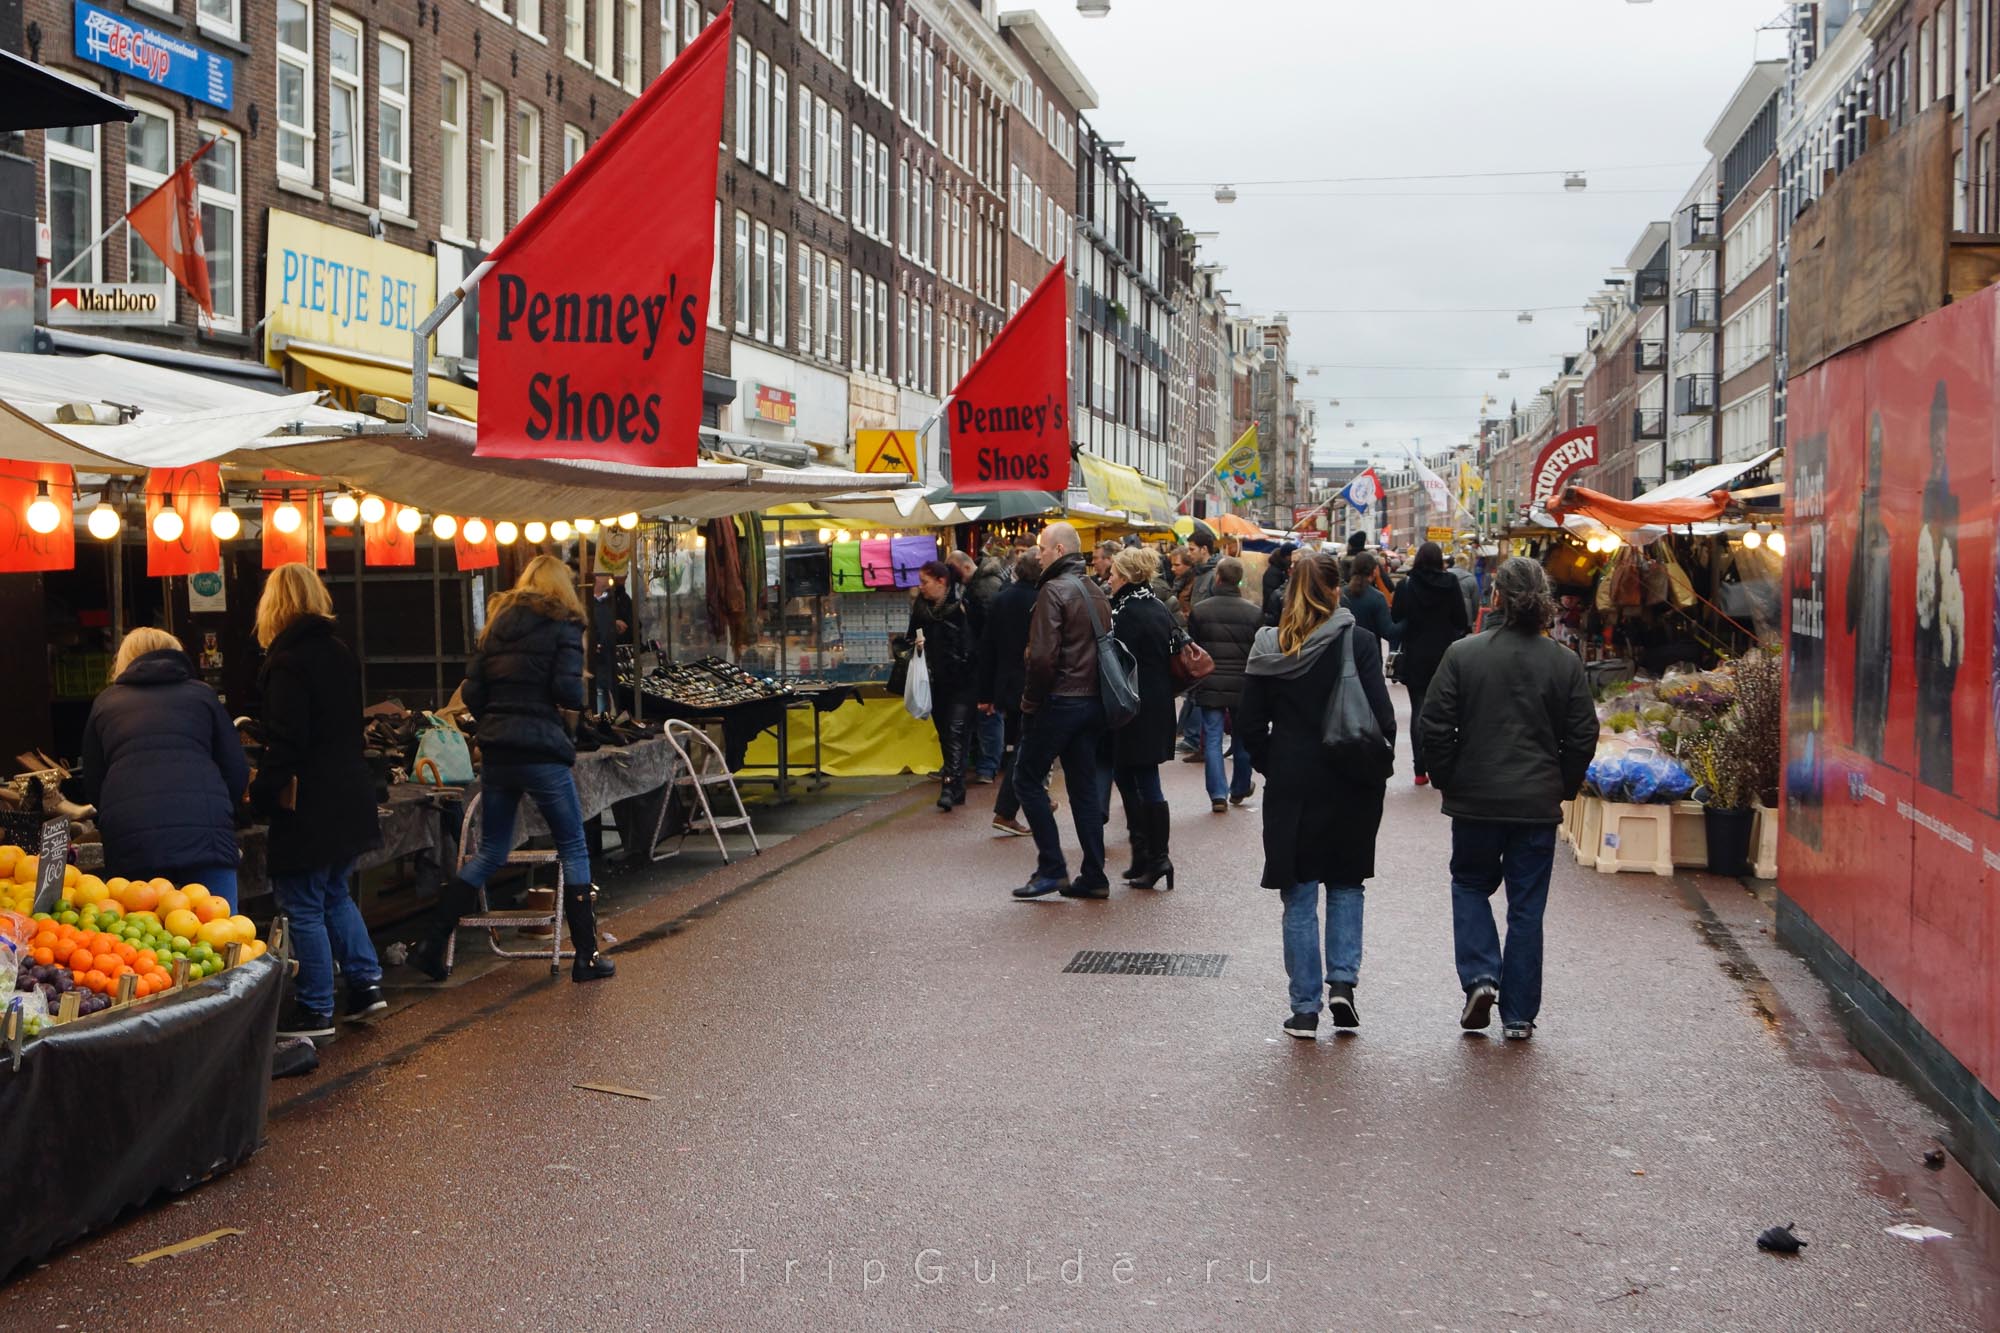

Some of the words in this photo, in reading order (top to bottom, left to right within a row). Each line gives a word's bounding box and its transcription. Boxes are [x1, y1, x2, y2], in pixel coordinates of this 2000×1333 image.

[108, 24, 129, 60] de
[131, 31, 170, 82] Cuyp
[78, 287, 158, 313] Marlboro
[281, 248, 370, 328] PIETJE
[496, 272, 699, 361] Penney's
[524, 371, 662, 444] Shoes
[956, 393, 1063, 438] Penney's
[977, 447, 1050, 482] Shoes
